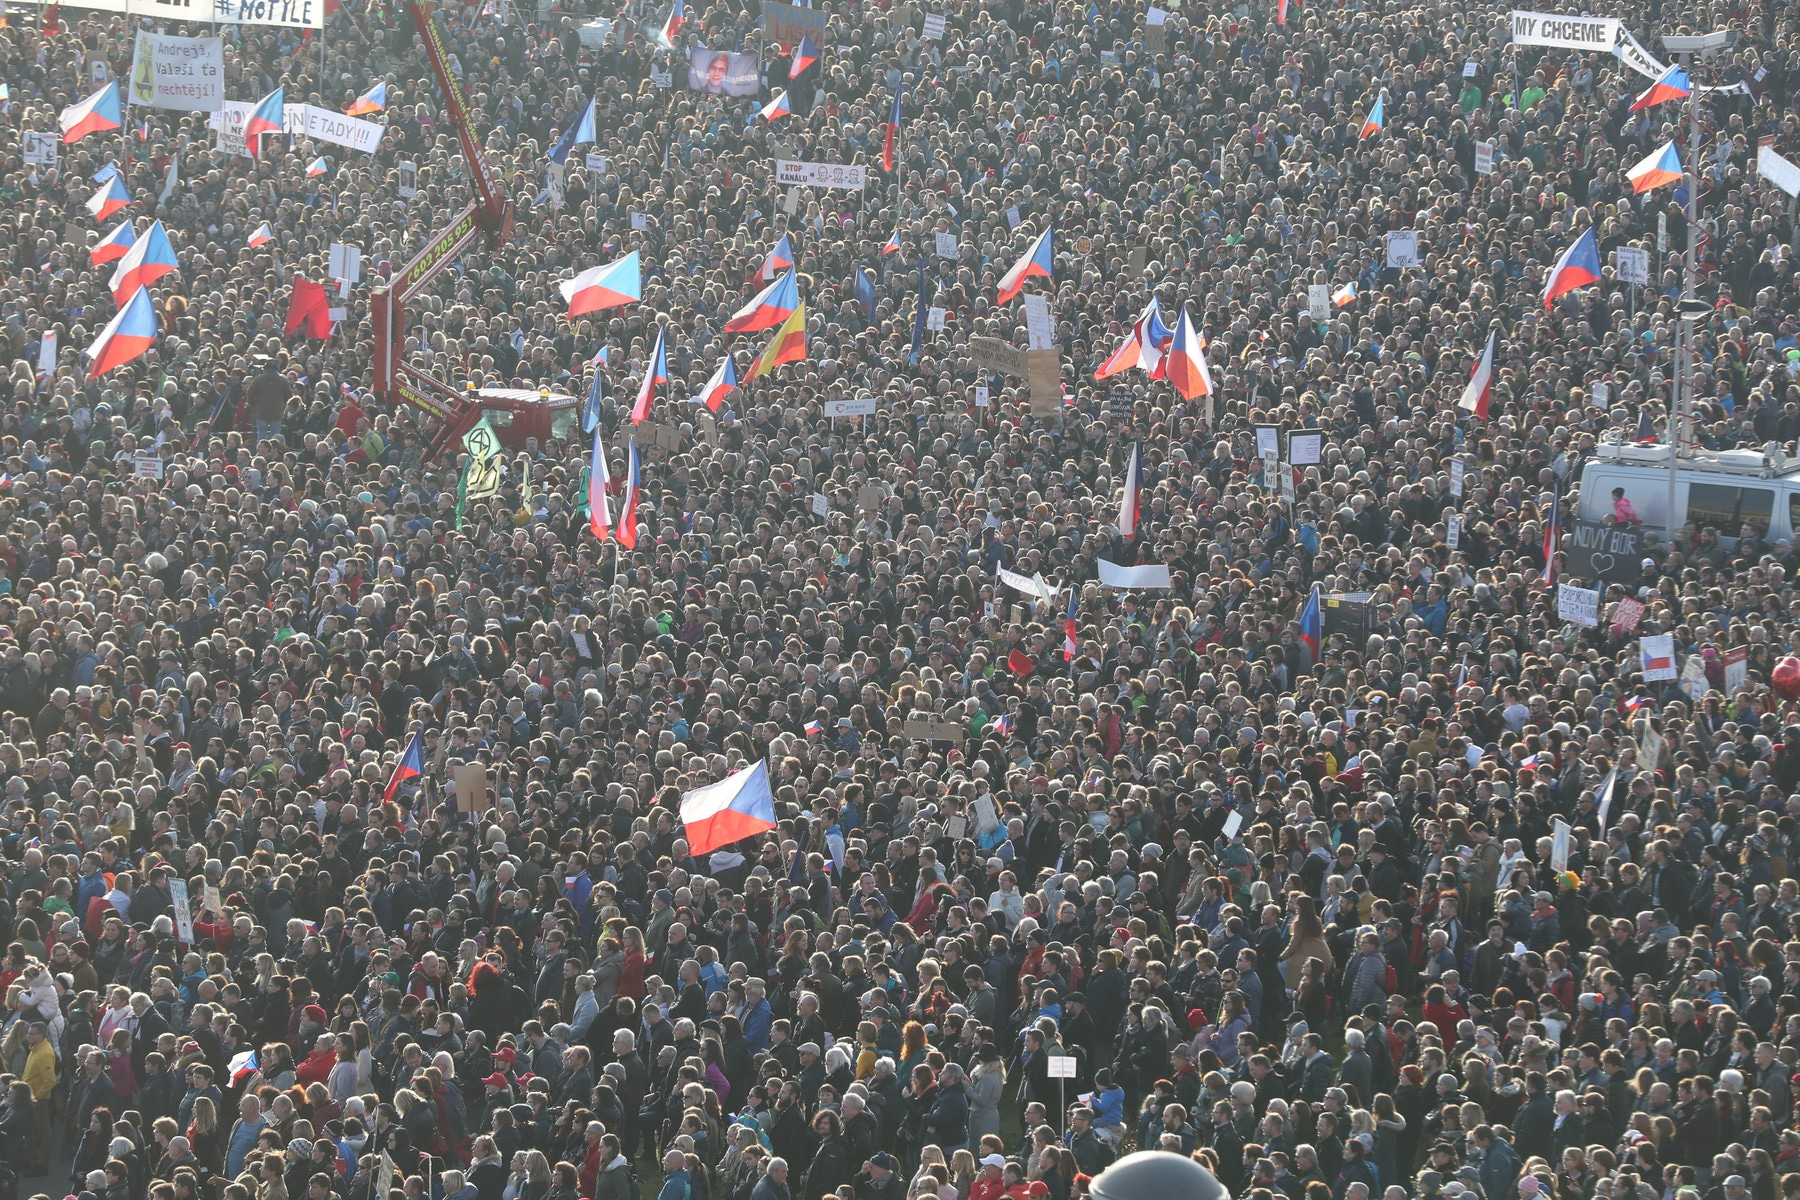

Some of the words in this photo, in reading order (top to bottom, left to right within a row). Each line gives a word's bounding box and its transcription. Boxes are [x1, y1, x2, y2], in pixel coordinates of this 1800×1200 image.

[1515, 16, 1537, 36] MY
[1541, 20, 1606, 43] CHCEME
[158, 83, 215, 99] nechtějí!
[321, 117, 354, 140] TADY
[356, 127, 370, 144] !!!
[474, 149, 497, 198] sico.cz
[780, 172, 808, 183] KANÁLU
[785, 164, 803, 172] STOP
[413, 253, 433, 279] 602
[434, 233, 454, 259] 205
[455, 214, 473, 240] 951
[1610, 531, 1637, 555] BOR
